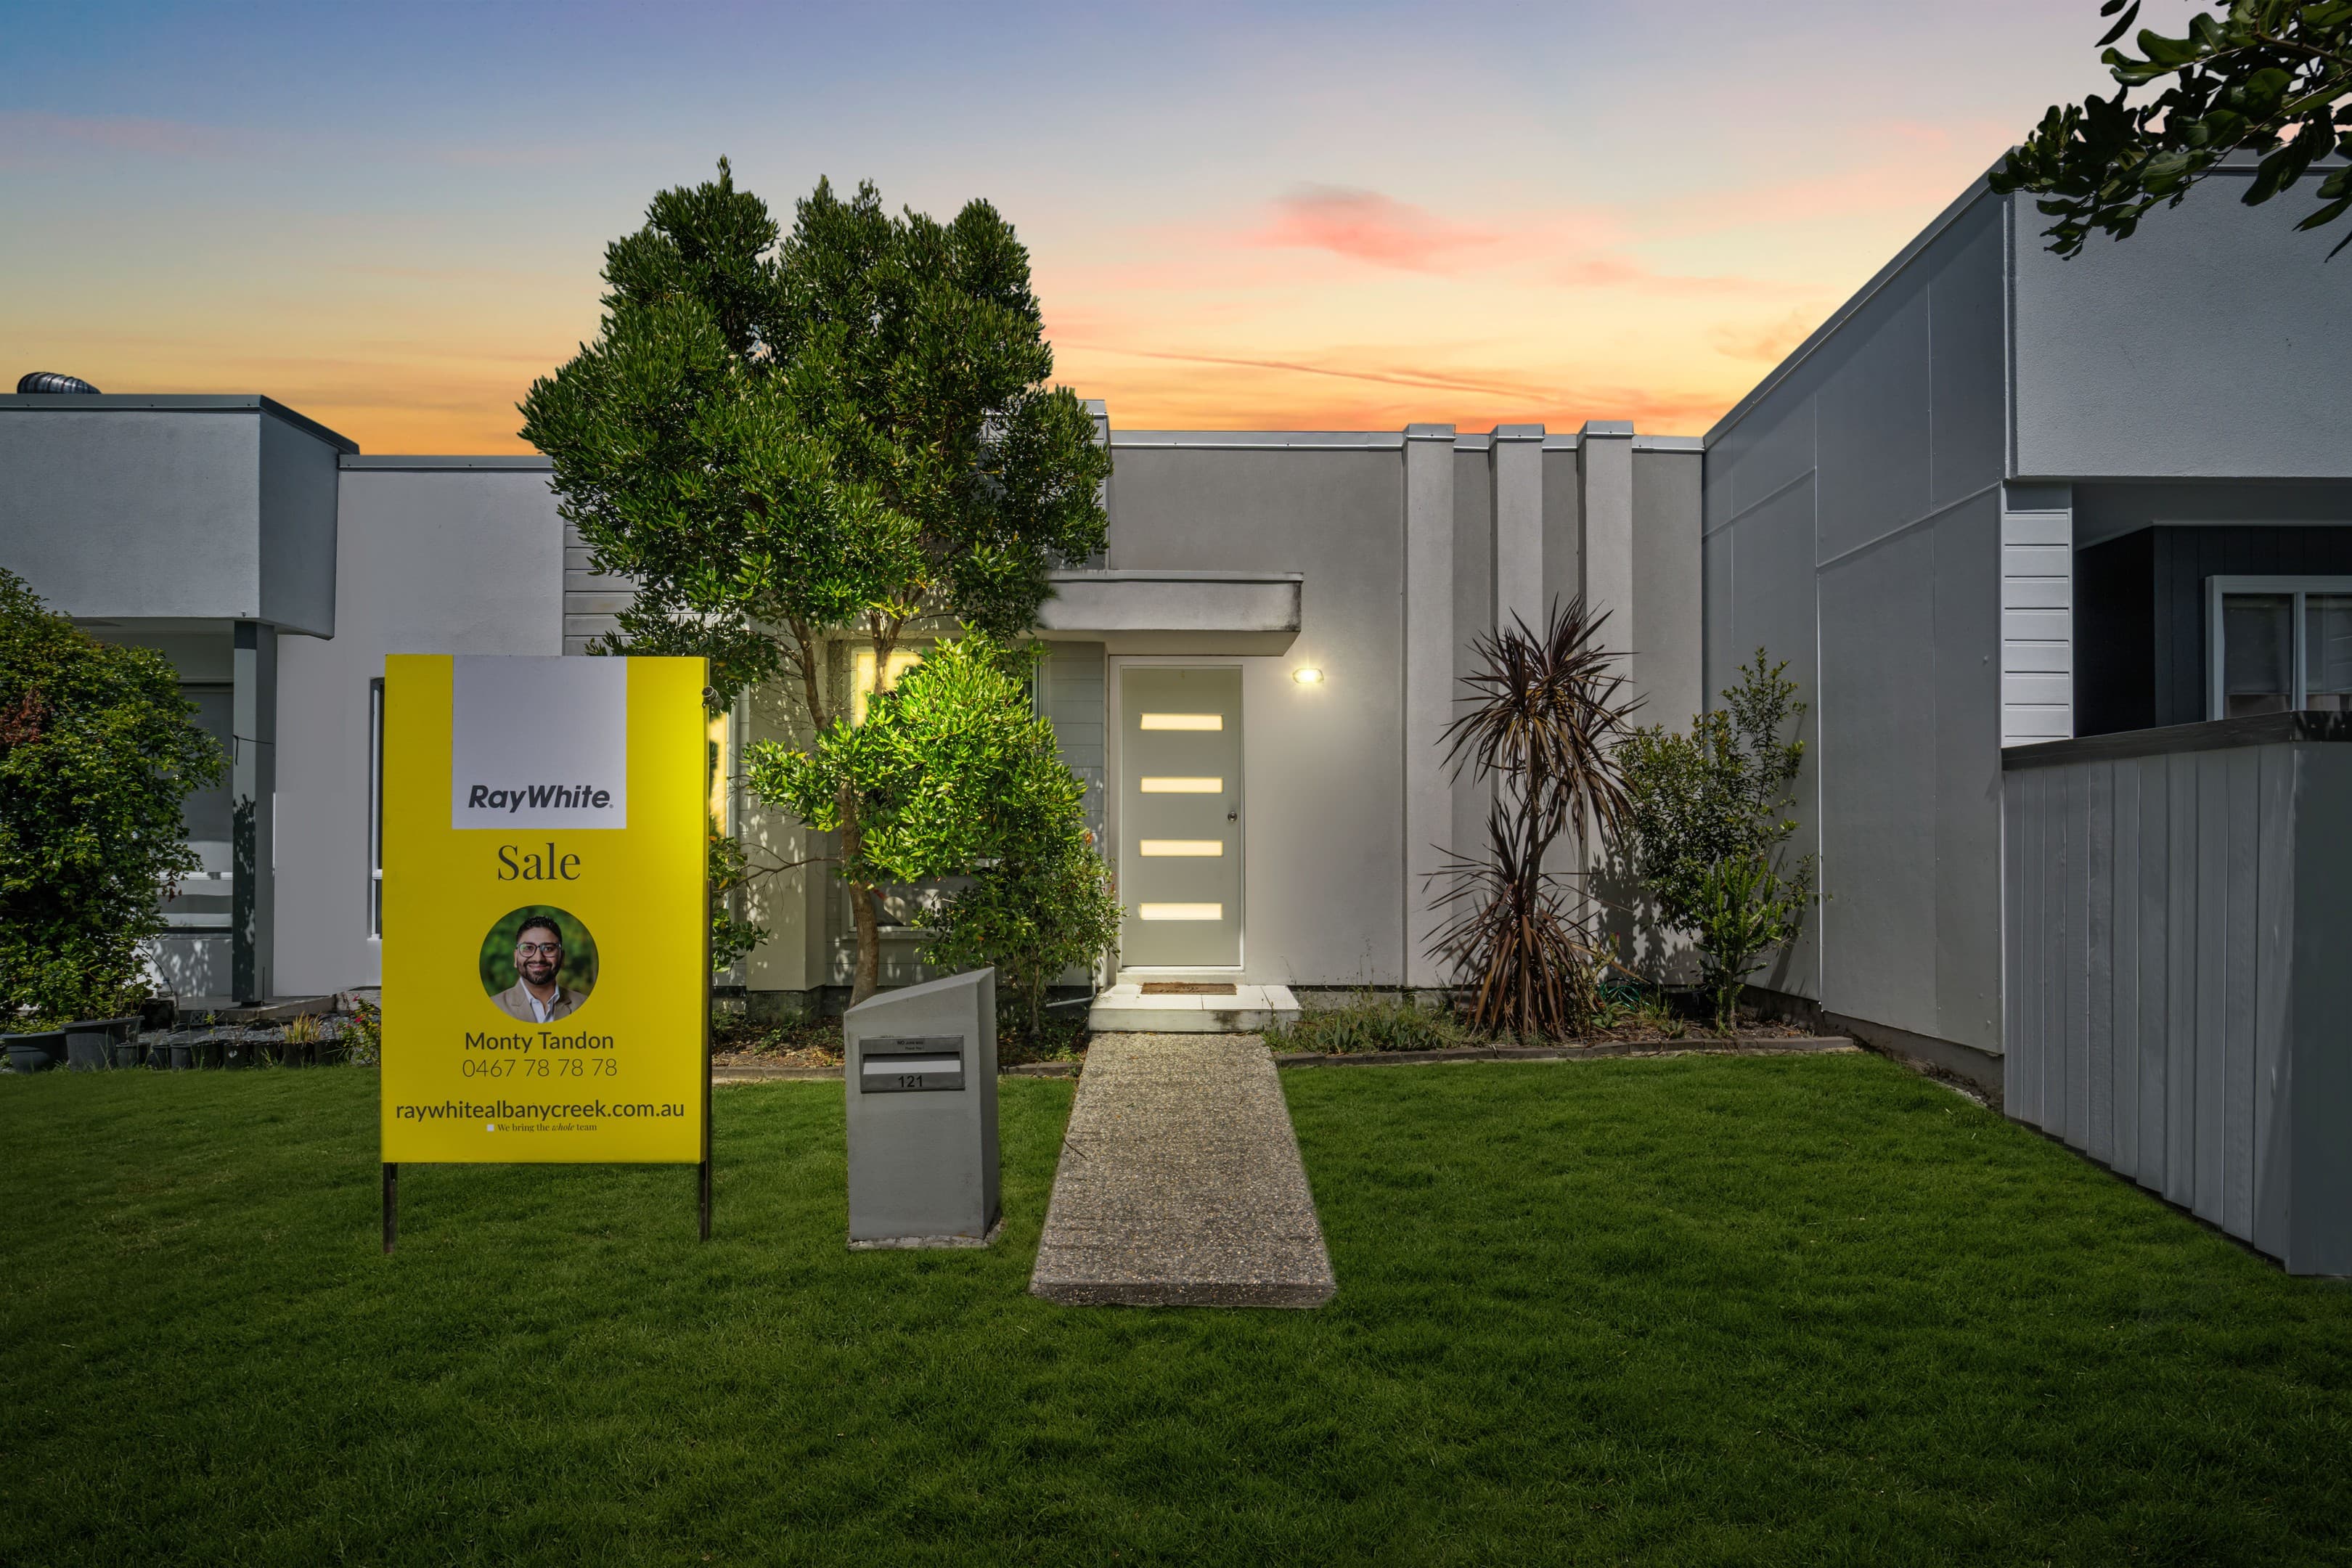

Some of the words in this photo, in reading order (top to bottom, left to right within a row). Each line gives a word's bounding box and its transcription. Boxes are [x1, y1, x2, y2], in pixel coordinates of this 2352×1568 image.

[498, 842, 581, 881] Sale
[465, 1032, 533, 1053] Monty
[538, 1031, 613, 1050] Tandon
[462, 1059, 516, 1077] 0467
[523, 1059, 550, 1077] 78
[558, 1058, 584, 1077] 78
[592, 1058, 617, 1077] 78
[898, 1075, 923, 1087] 121
[396, 1099, 685, 1122] raywhitealbanycreek.com.au
[512, 1123, 534, 1133] bring
[536, 1123, 550, 1132] the
[552, 1122, 575, 1132] whole
